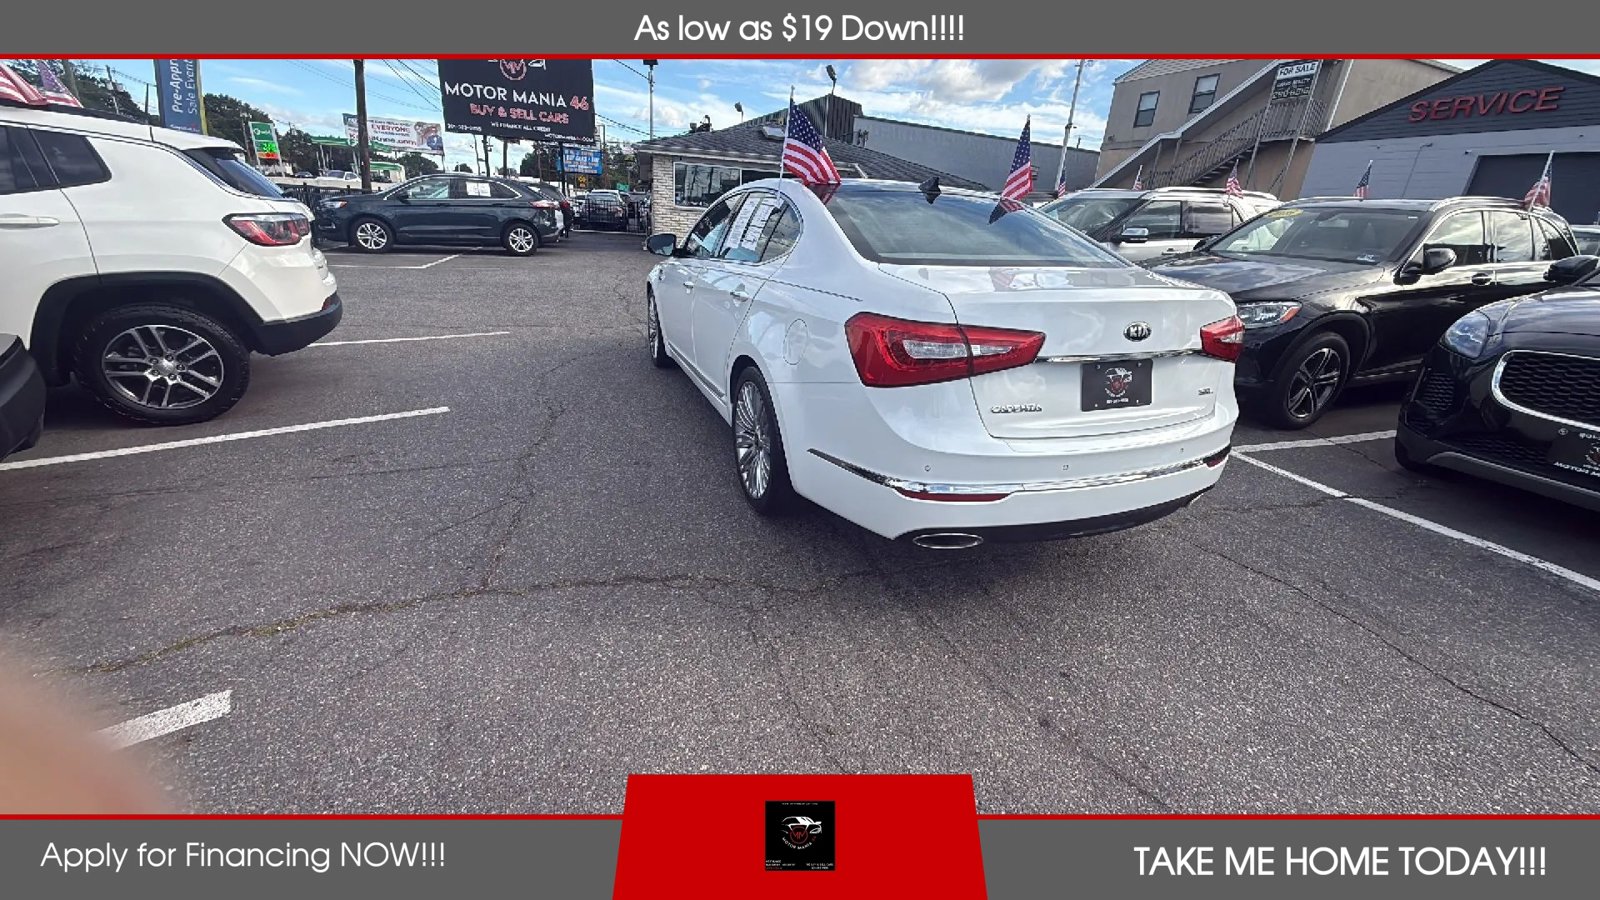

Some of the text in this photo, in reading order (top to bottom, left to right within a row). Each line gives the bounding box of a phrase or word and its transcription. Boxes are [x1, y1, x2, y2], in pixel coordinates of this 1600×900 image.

[1280, 62, 1316, 76] FOR SALE
[186, 93, 198, 115] Sale
[444, 81, 590, 111] MOTOR MANIA 46
[1408, 85, 1566, 124] SERVICE
[469, 103, 570, 125] BUY & SELL CARS
[1129, 325, 1150, 338] KIA
